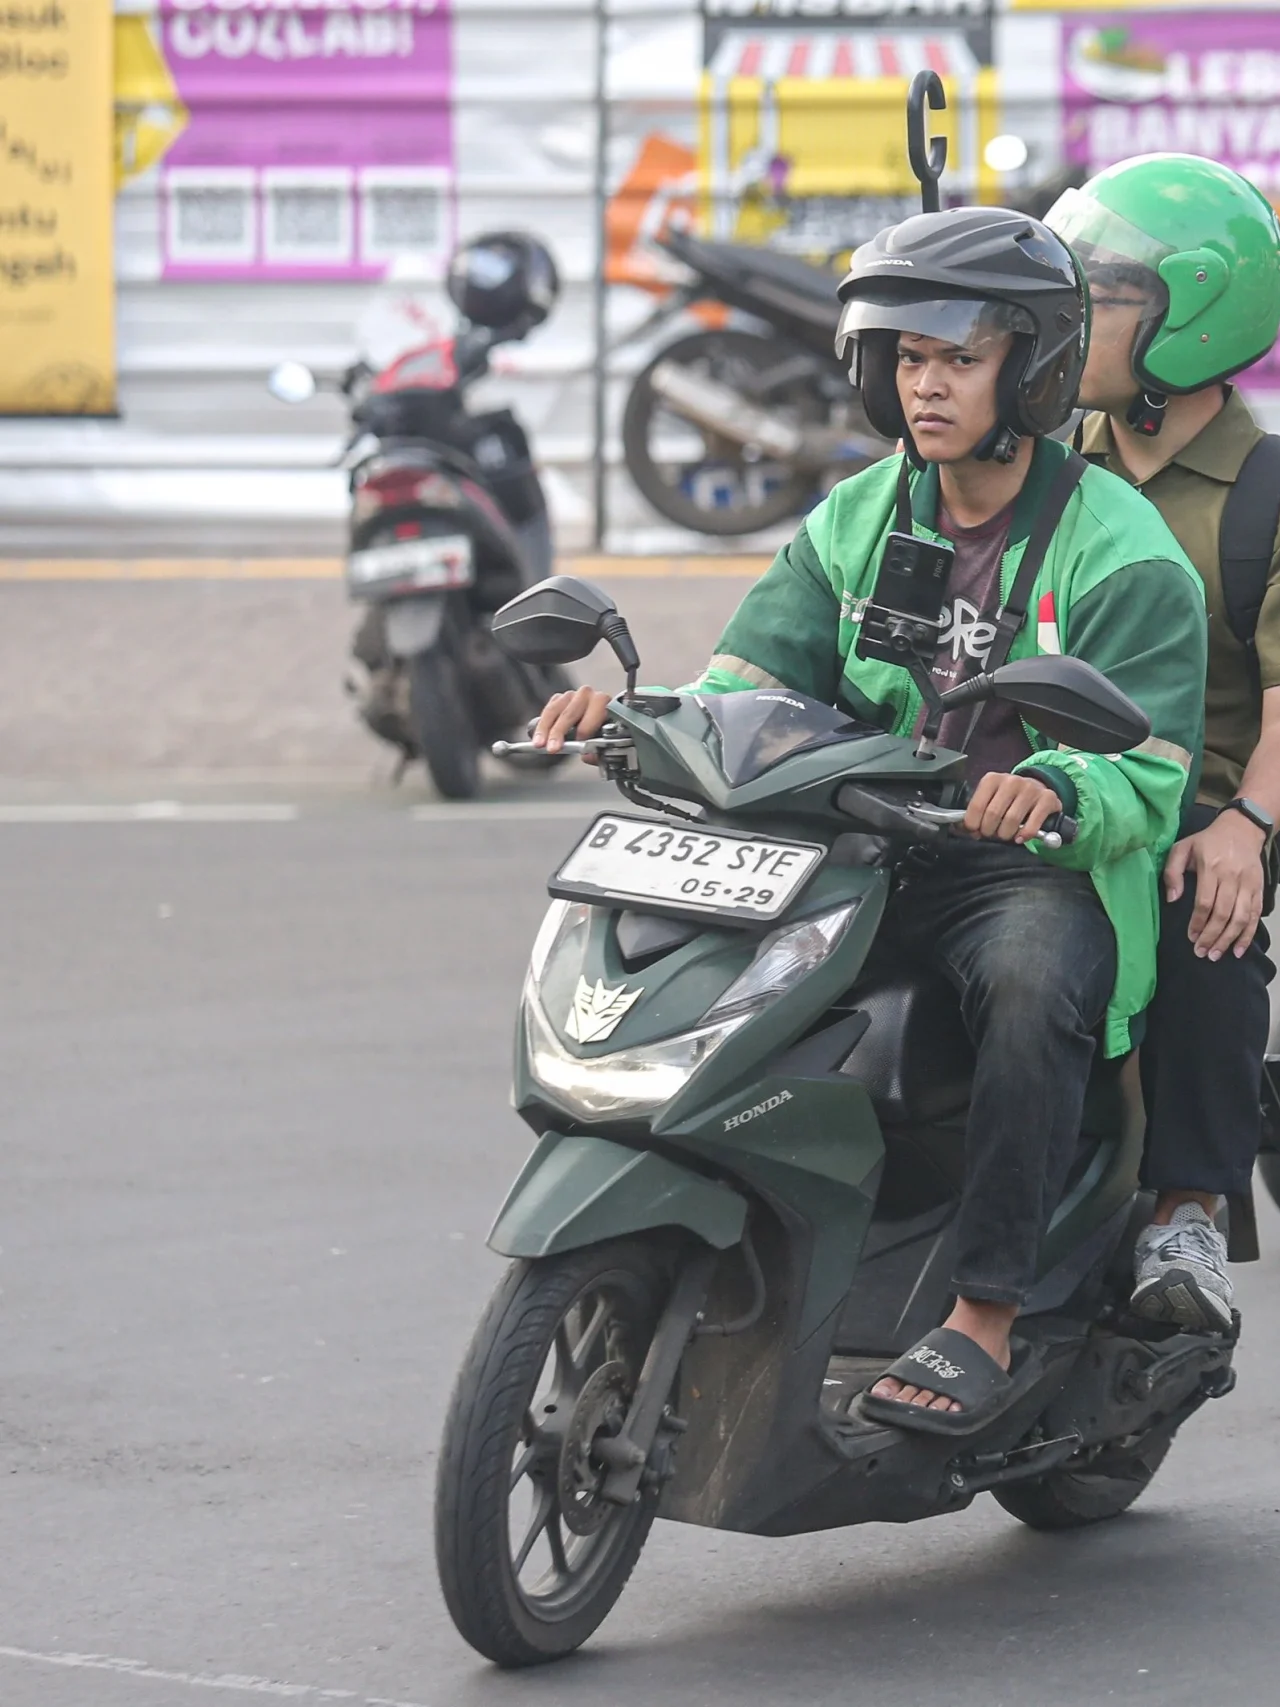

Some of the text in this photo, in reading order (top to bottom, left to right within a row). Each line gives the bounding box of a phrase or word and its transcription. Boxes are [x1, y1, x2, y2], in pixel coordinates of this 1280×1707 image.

[864, 258, 915, 268] HONDA
[933, 558, 944, 578] POCO
[755, 695, 806, 710] HONDA
[588, 823, 801, 877] B 4352 SYE
[723, 1089, 794, 1132] HONDA
